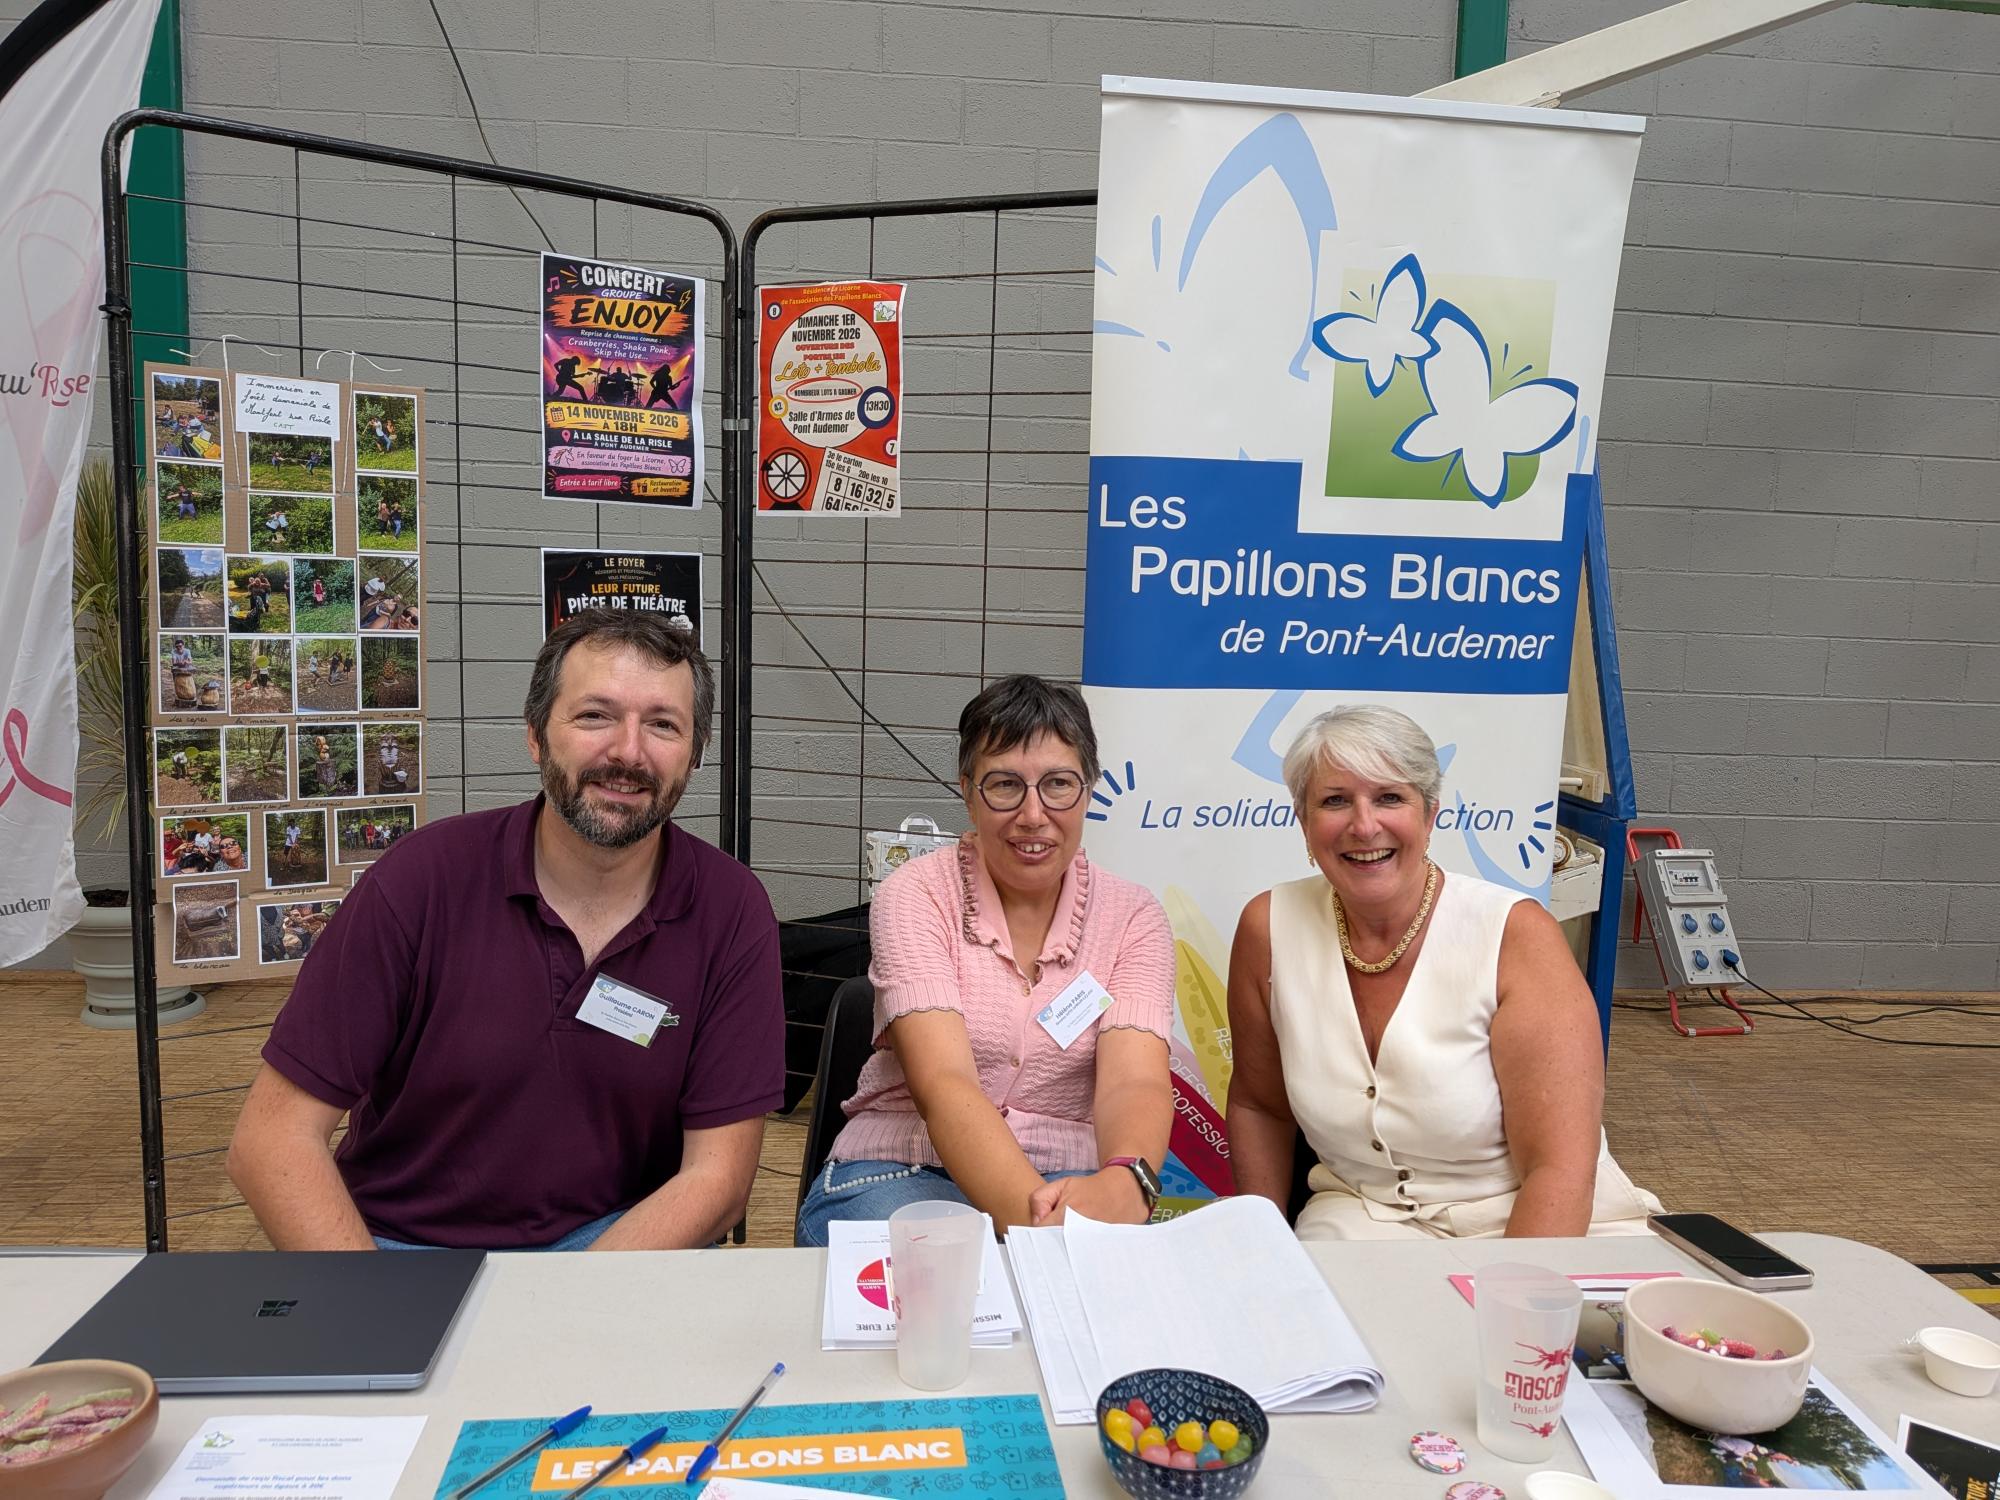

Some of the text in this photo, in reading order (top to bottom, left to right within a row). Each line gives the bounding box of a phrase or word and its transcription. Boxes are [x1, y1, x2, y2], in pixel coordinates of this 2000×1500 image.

[581, 265, 665, 297] CONCERT
[601, 288, 642, 300] GROUPE
[834, 293, 862, 302] Papillons
[862, 292, 882, 300] Blancs
[569, 298, 673, 333] ENJOY
[771, 307, 777, 316] 8
[797, 313, 856, 328] DIMANCHE 1ER
[580, 329, 603, 339] Reprise
[604, 330, 612, 338] de
[613, 332, 639, 341] chansons
[639, 335, 658, 343] comme
[791, 327, 861, 342] NOVEMBRE 2026
[594, 347, 613, 358] Skip
[614, 348, 627, 358] the
[622, 342, 648, 353] Shaka
[775, 361, 811, 381] Loto
[814, 363, 823, 373] +
[322, 402, 331, 410] de
[865, 400, 889, 412] 13H30
[309, 414, 332, 425] Risle
[566, 405, 679, 429] 14 NOVEMBRE 2026
[788, 409, 855, 422] Salle d'Armes de
[602, 419, 638, 433] À 18H
[792, 422, 849, 435] Pont Audemer
[573, 429, 673, 449] À LA SALLE DE LA RISLE
[600, 441, 617, 449] PONT
[619, 443, 650, 451] AUDEMER
[889, 442, 896, 454] 7
[576, 451, 586, 459] En
[586, 452, 606, 460] faveur
[608, 453, 616, 461] du
[617, 454, 633, 464] foyer
[836, 453, 842, 462] le
[842, 455, 863, 469] carton
[581, 460, 662, 471] association les Papillons Blancs
[836, 463, 846, 472] les
[870, 472, 881, 483] les
[881, 476, 889, 486] 10
[559, 478, 580, 487] Entrée
[587, 478, 603, 486] tarif
[603, 478, 618, 487] libre
[649, 480, 683, 488] Restauration
[833, 477, 895, 509] 8 16 32 5
[824, 496, 840, 511] 64
[1098, 483, 1188, 530] Les
[604, 557, 646, 568] LE FOYER
[1130, 545, 1560, 606] Papillons Blancs
[591, 583, 661, 594] LEUR FUTURE
[567, 593, 687, 614] PIÈCE DE THÉÂTRE
[1219, 619, 1555, 660] de Pont-Audemer
[1140, 799, 1183, 829] La
[598, 992, 633, 1010] Guillaume
[632, 1004, 655, 1021] CARON
[855, 1323, 878, 1331] EURE
[833, 1441, 953, 1464] BLANC
